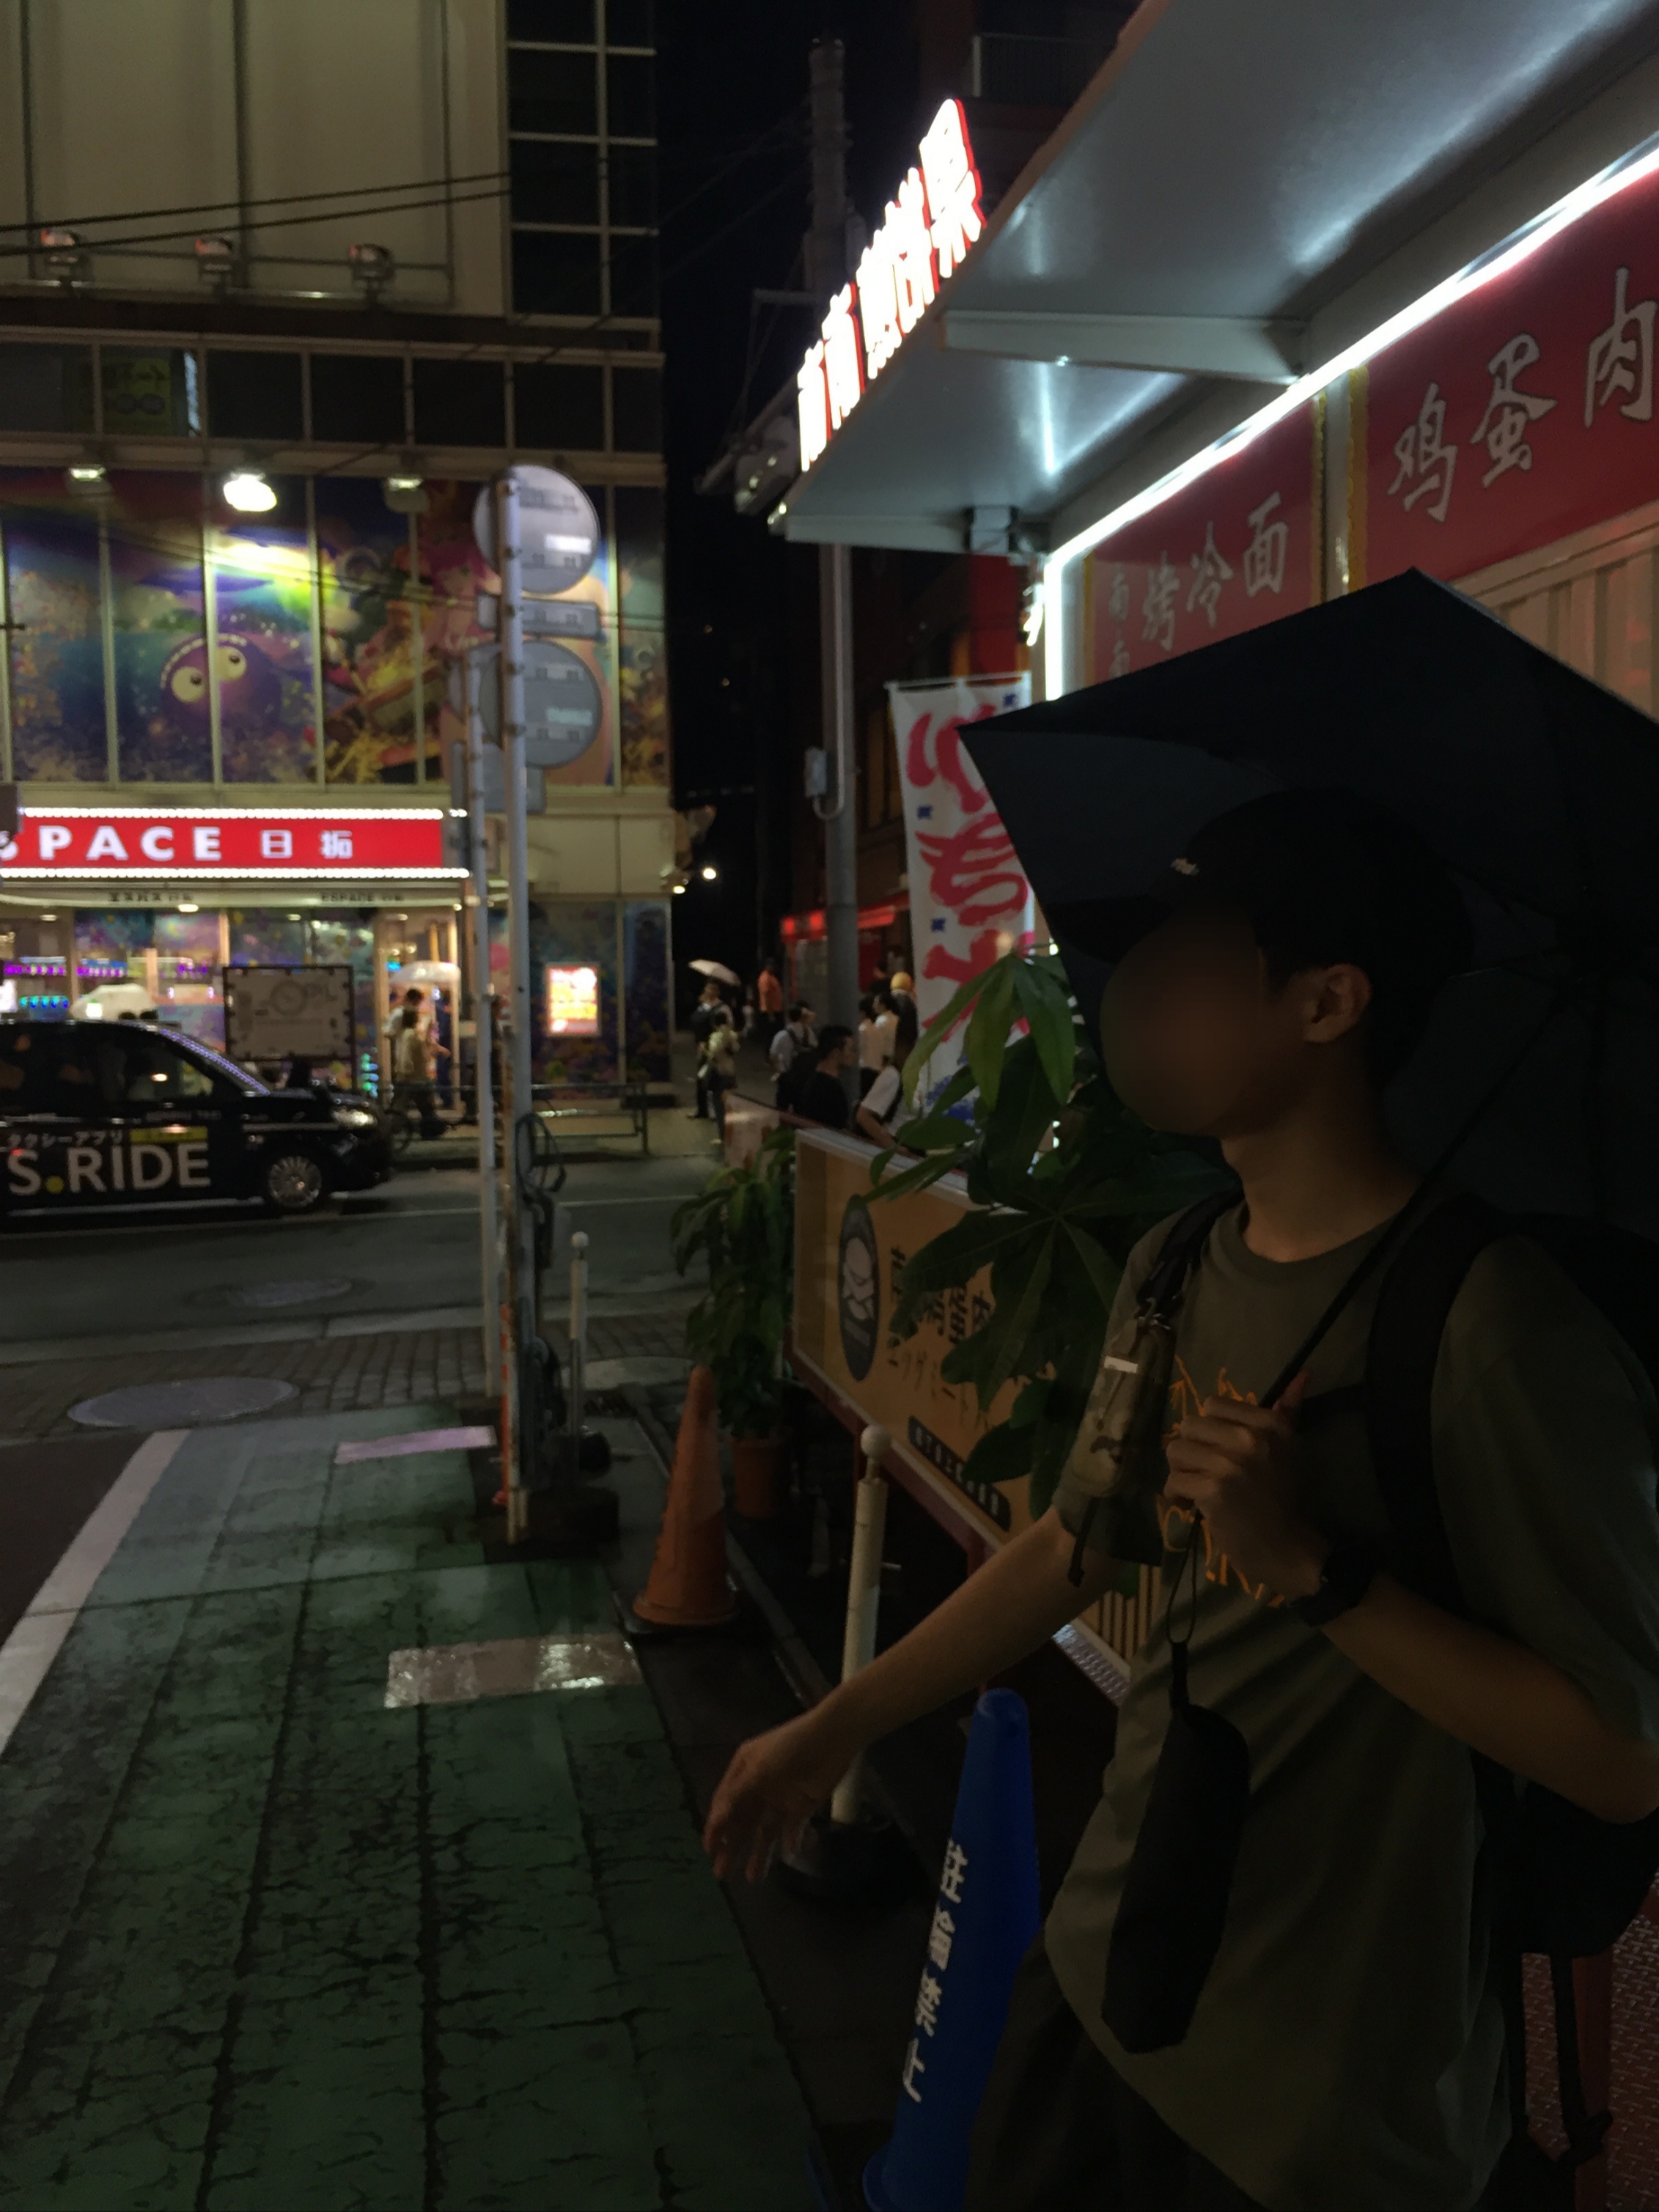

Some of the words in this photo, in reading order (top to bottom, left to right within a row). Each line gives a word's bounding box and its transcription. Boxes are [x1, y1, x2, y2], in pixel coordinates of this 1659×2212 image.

[1387, 265, 1658, 523] 鸡蛋肉
[7, 1141, 212, 1196] S.RIDE
